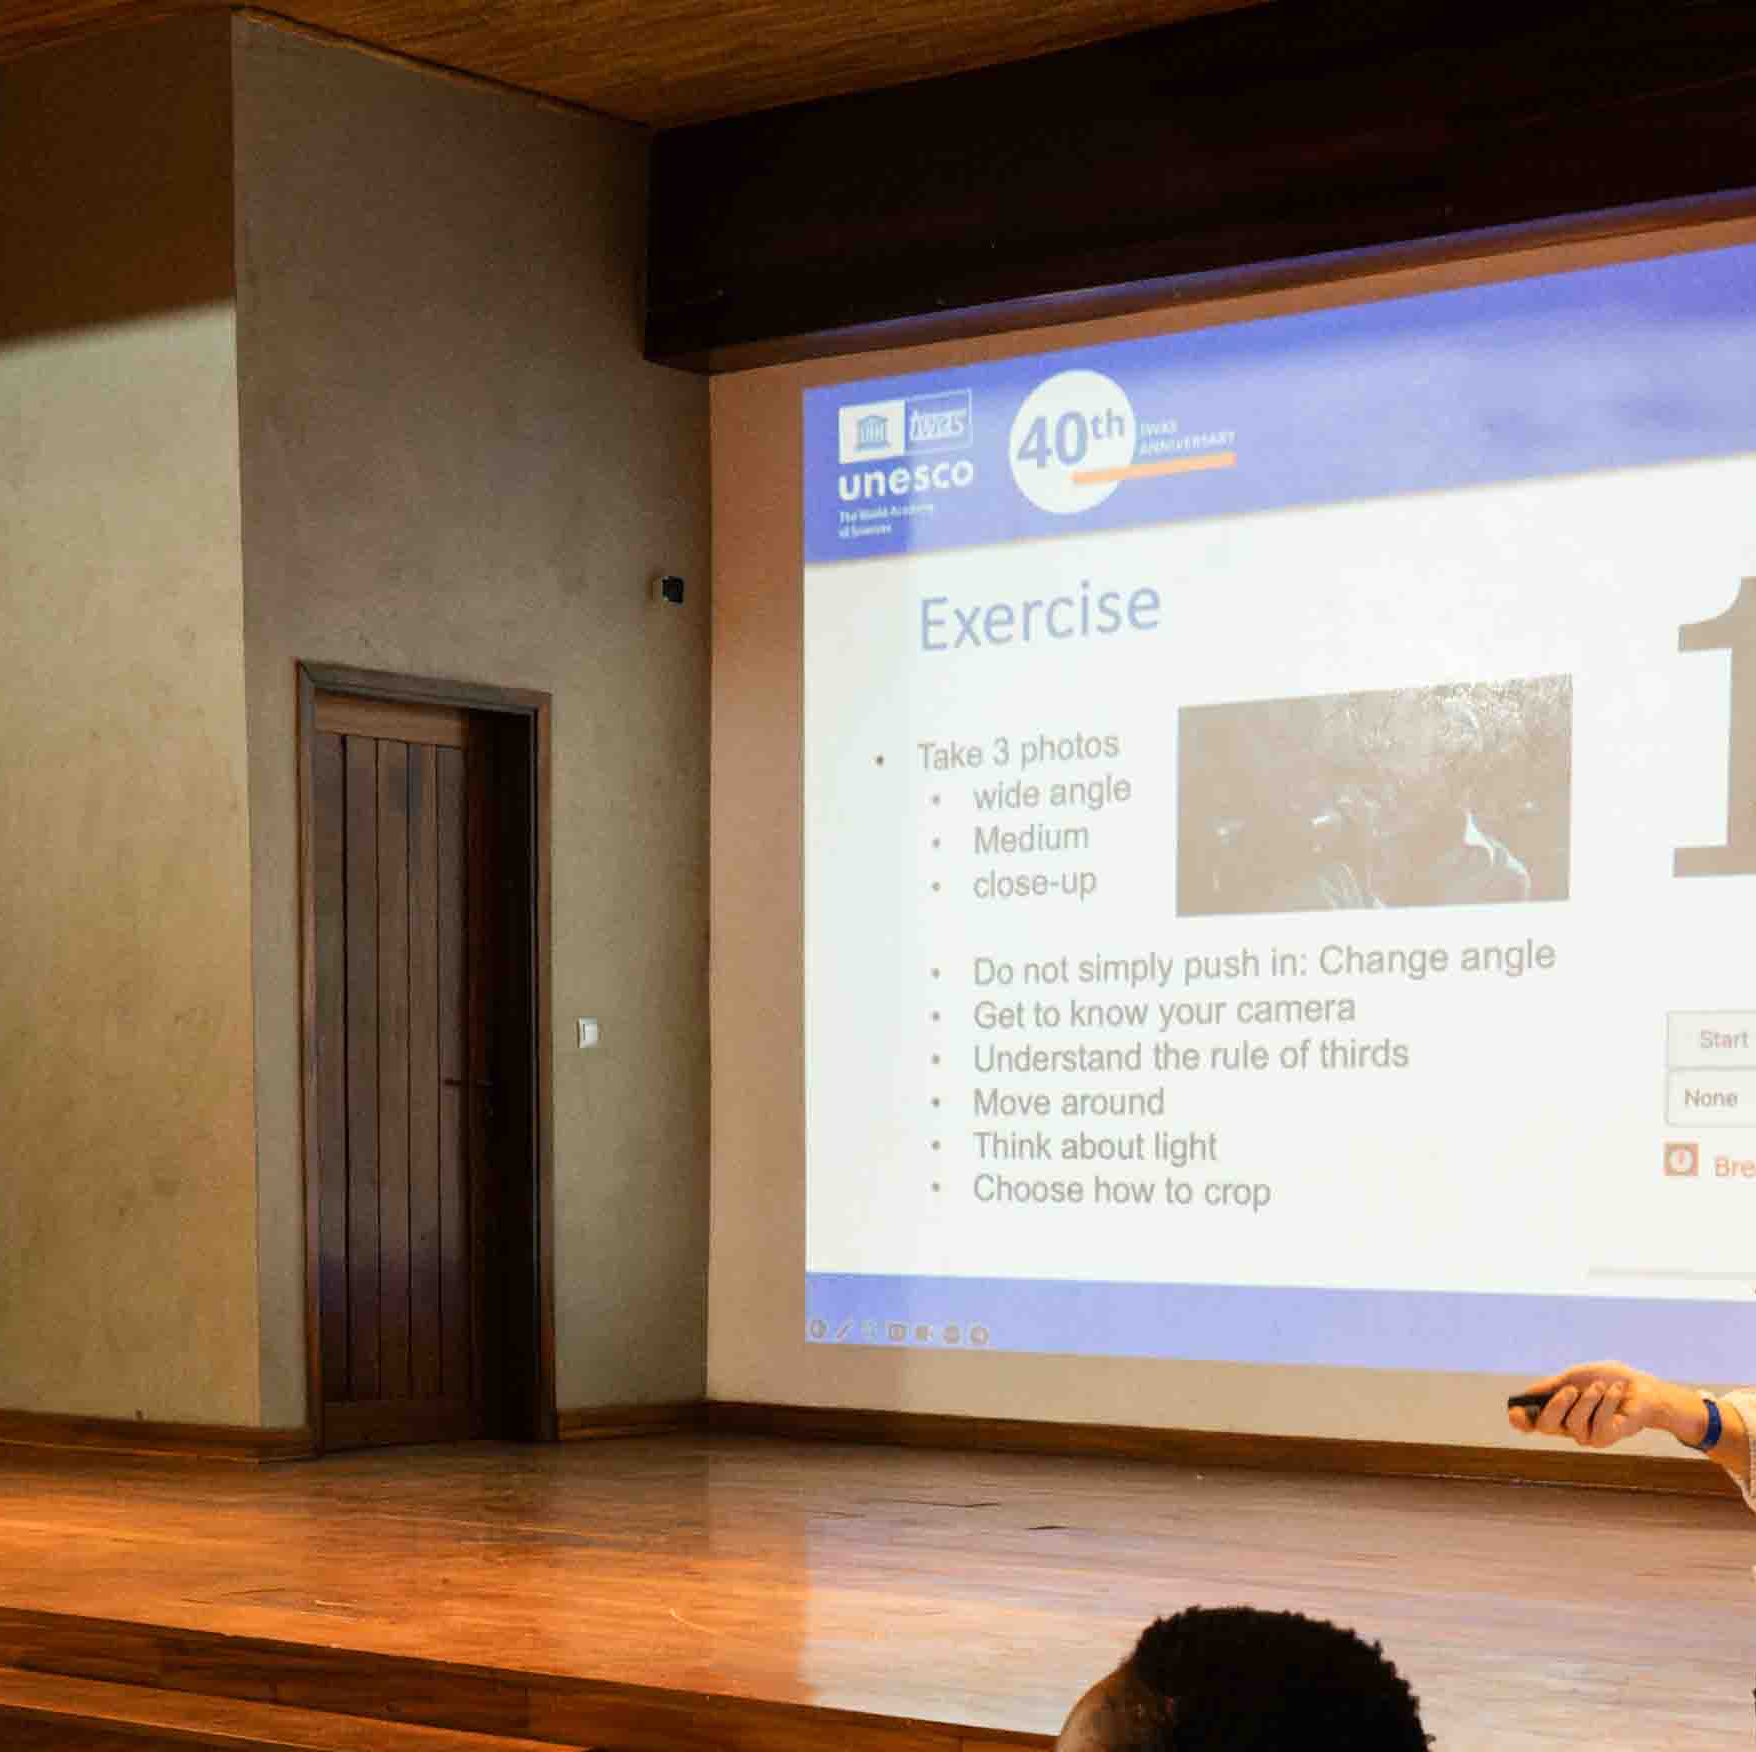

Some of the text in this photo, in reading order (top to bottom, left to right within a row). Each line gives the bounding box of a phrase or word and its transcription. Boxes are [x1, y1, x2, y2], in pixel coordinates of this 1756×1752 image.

[1016, 407, 1125, 469] 40th
[838, 460, 974, 502] unesco
[920, 578, 1162, 653] Exercise
[915, 731, 1121, 772] Take 3 photos
[971, 773, 1133, 813] wide angle
[972, 822, 1090, 856] Medium
[971, 867, 1098, 904] close-up
[972, 937, 1558, 990] Do not simply push in: Change angle
[972, 996, 1358, 1035] Get to know your camera
[972, 1036, 1411, 1074] Understand the rule of thirds
[1698, 1027, 1752, 1051] Start
[972, 1085, 1167, 1118] Move around
[1682, 1084, 1740, 1110] None
[971, 1130, 1219, 1170] Think about light
[972, 1172, 1274, 1214] Choose how to crop
